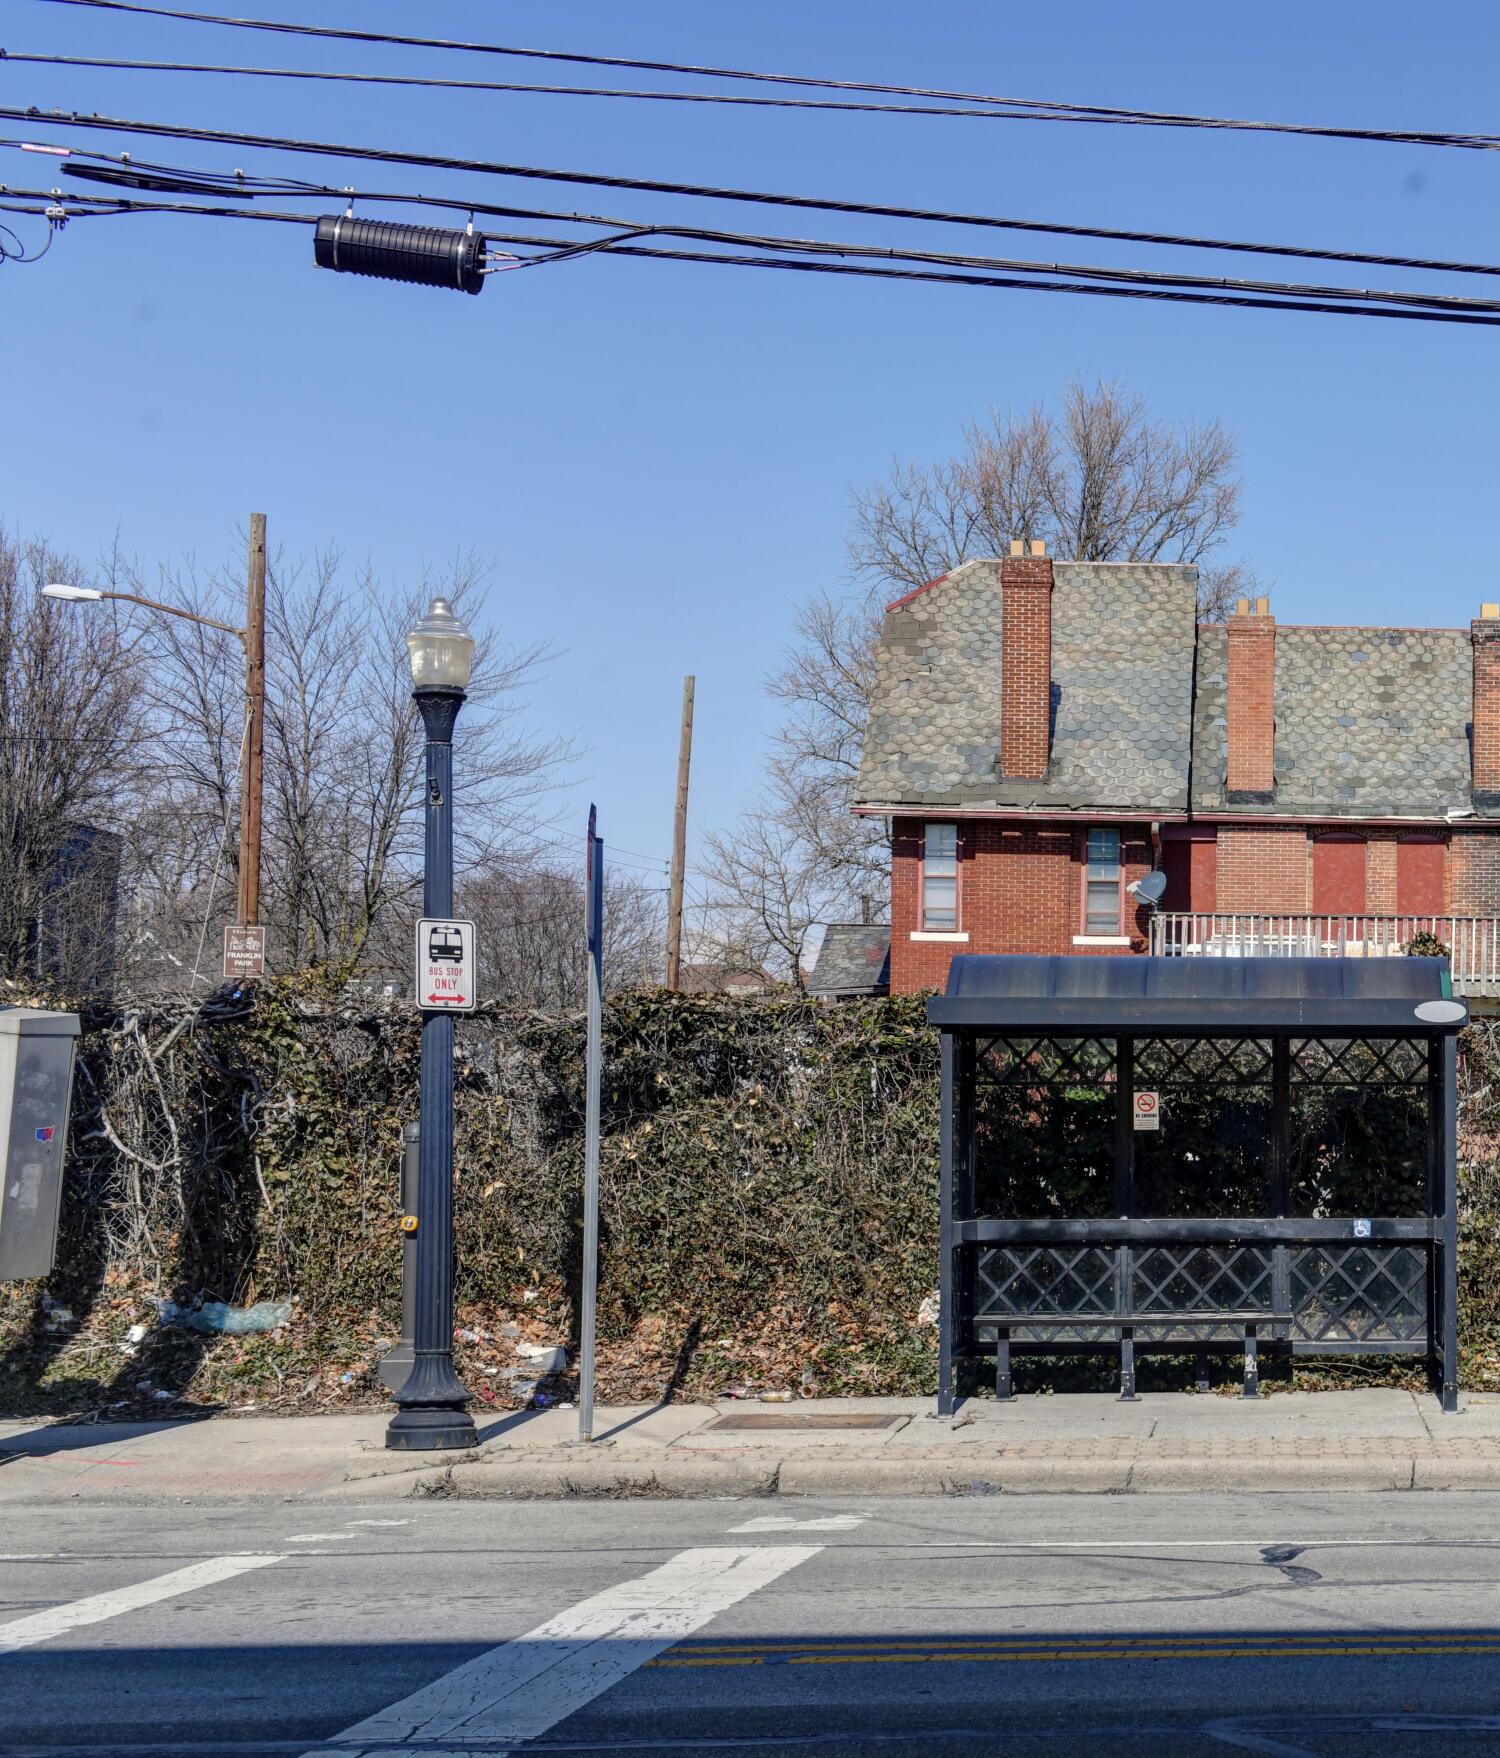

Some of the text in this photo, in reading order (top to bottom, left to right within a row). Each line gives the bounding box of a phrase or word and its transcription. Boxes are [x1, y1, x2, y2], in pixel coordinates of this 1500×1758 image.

[234, 959, 254, 967] PARK
[429, 967, 464, 977] BUS STOP
[434, 979, 458, 990] ONLY
